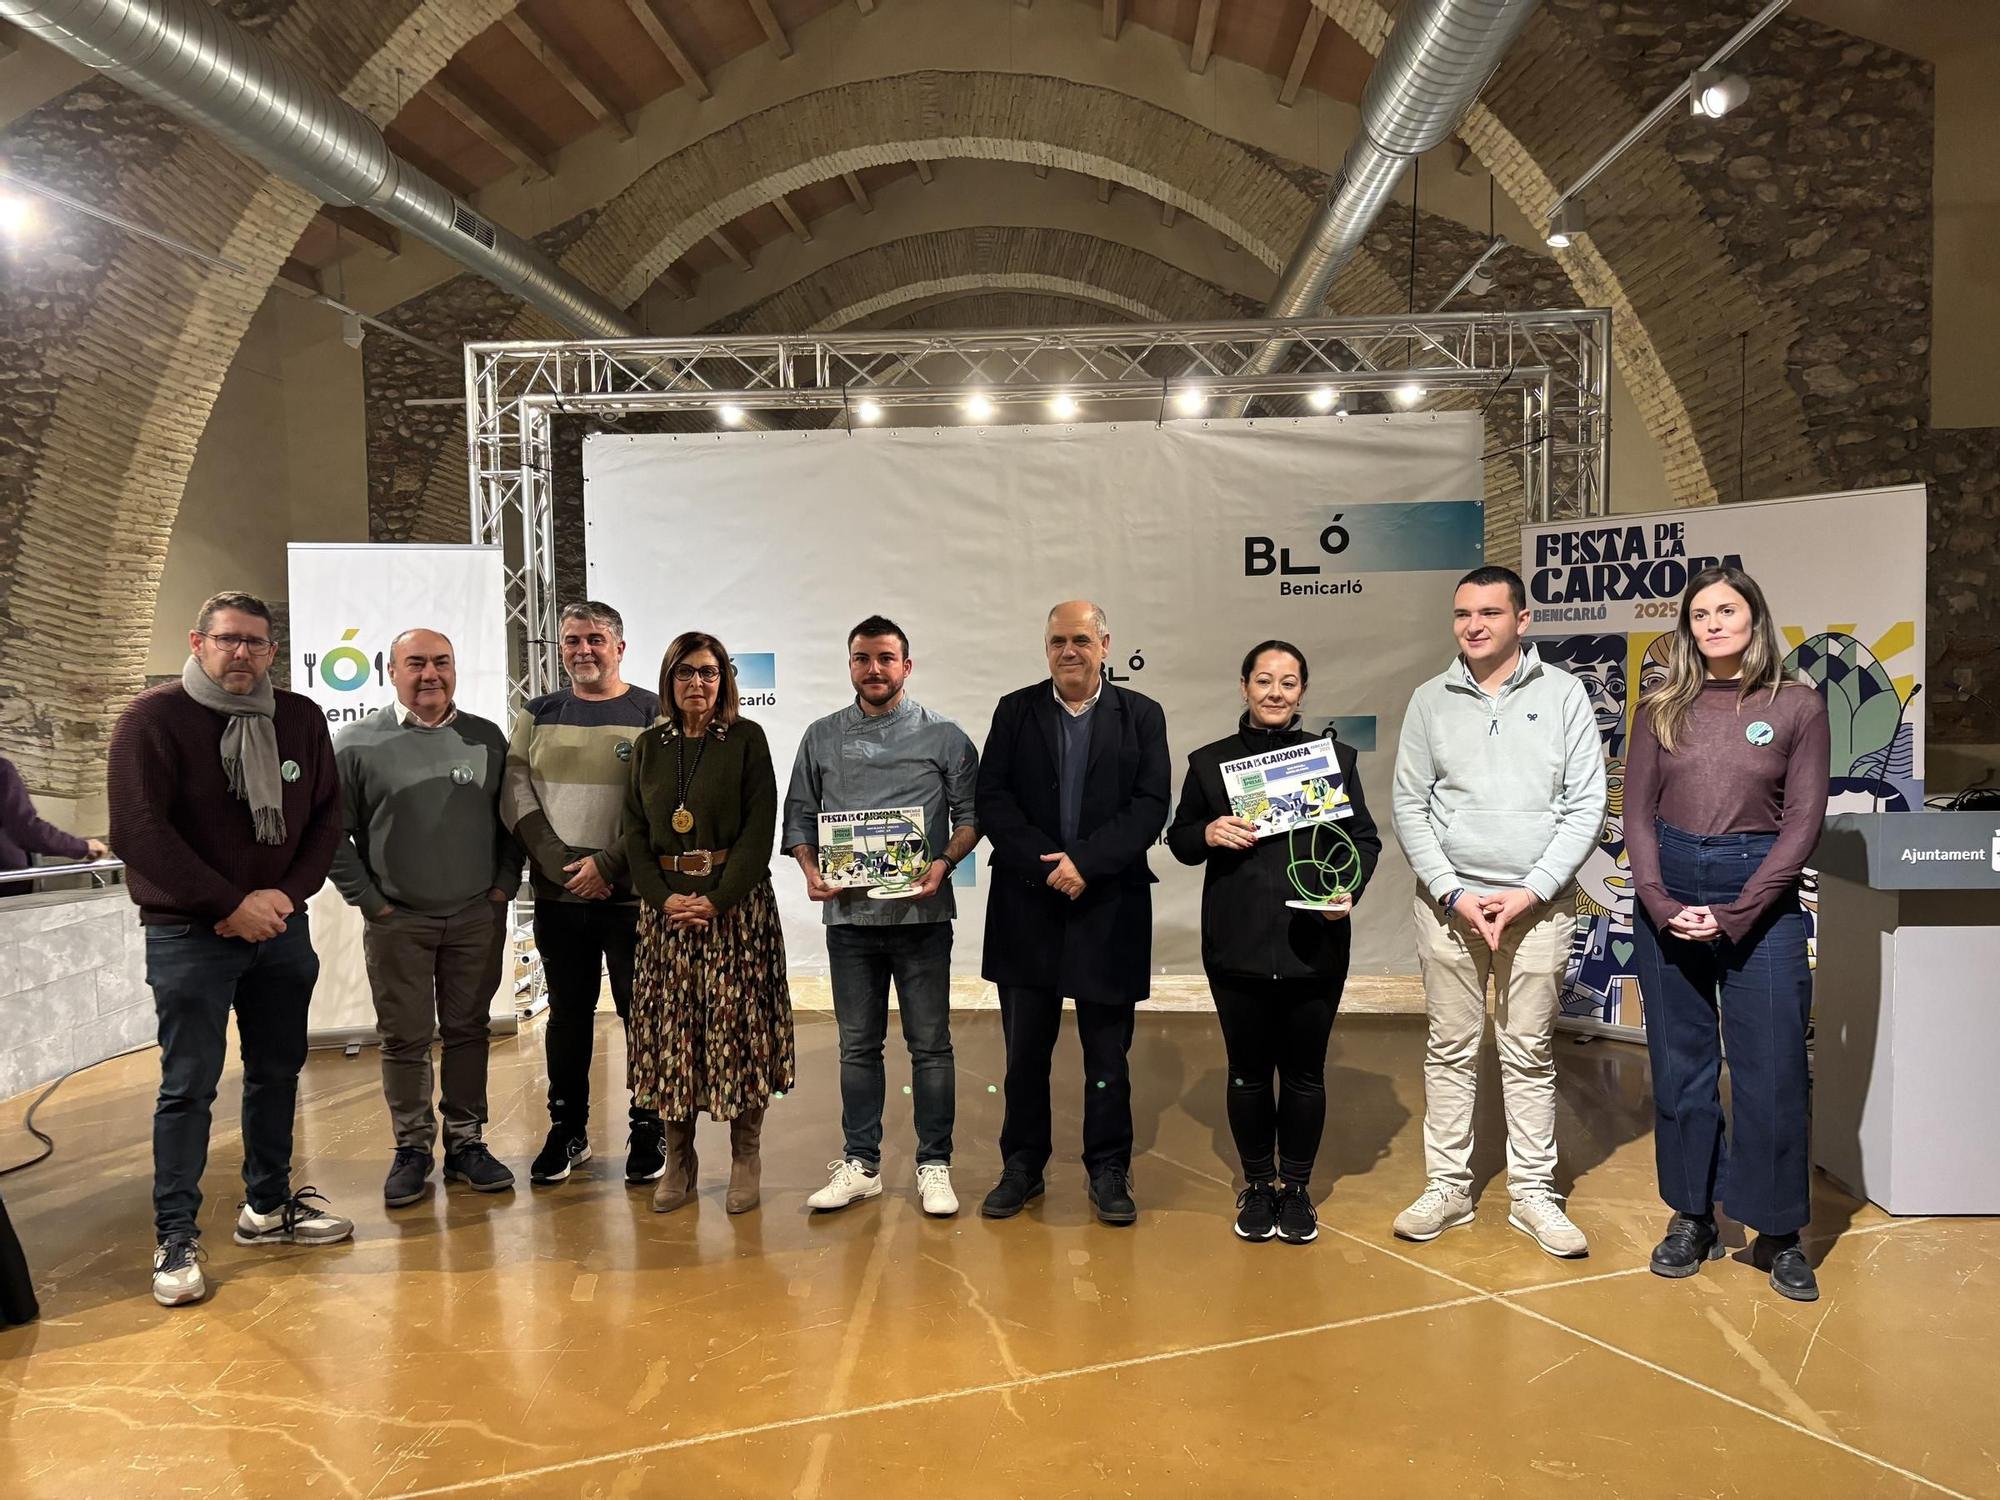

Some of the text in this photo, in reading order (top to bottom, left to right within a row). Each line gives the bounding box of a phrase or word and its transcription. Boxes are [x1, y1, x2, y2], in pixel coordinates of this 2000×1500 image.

[1654, 521, 1685, 541] DE
[1535, 525, 1648, 567] FESTA
[1654, 539, 1687, 558] LA
[1280, 580, 1363, 596] Benicarló
[1532, 602, 1679, 623] BENICARLÓ 2025
[739, 693, 776, 706] carló
[1225, 759, 1254, 774] FESTA
[1262, 747, 1311, 765] CARXOFA
[1901, 848, 1986, 864] Ajuntament
